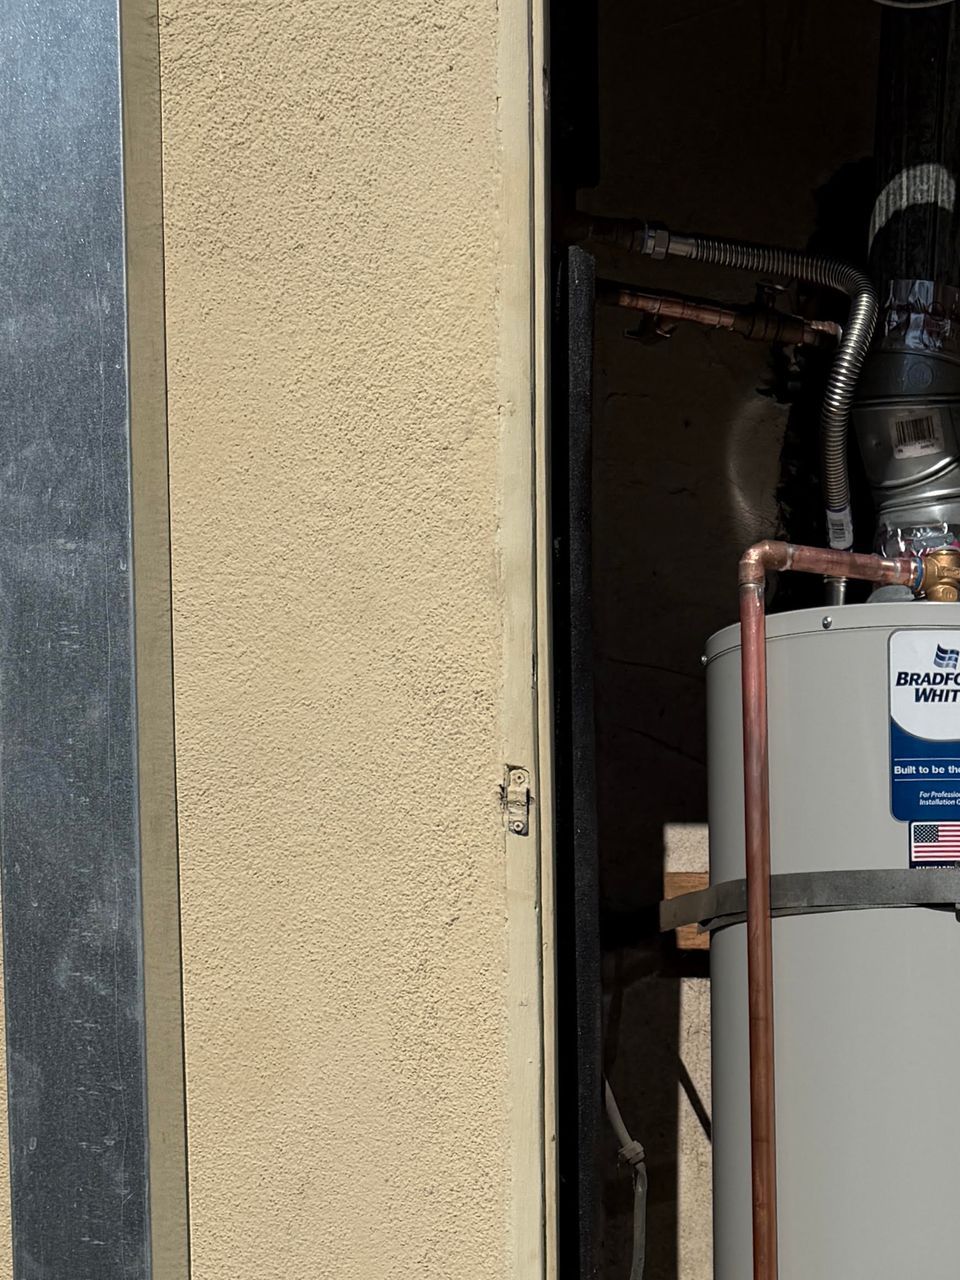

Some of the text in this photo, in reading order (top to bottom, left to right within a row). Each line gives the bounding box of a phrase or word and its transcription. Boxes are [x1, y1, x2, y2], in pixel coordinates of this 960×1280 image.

[894, 765, 916, 774] Built
[919, 766, 929, 774] to
[931, 765, 945, 774] be
